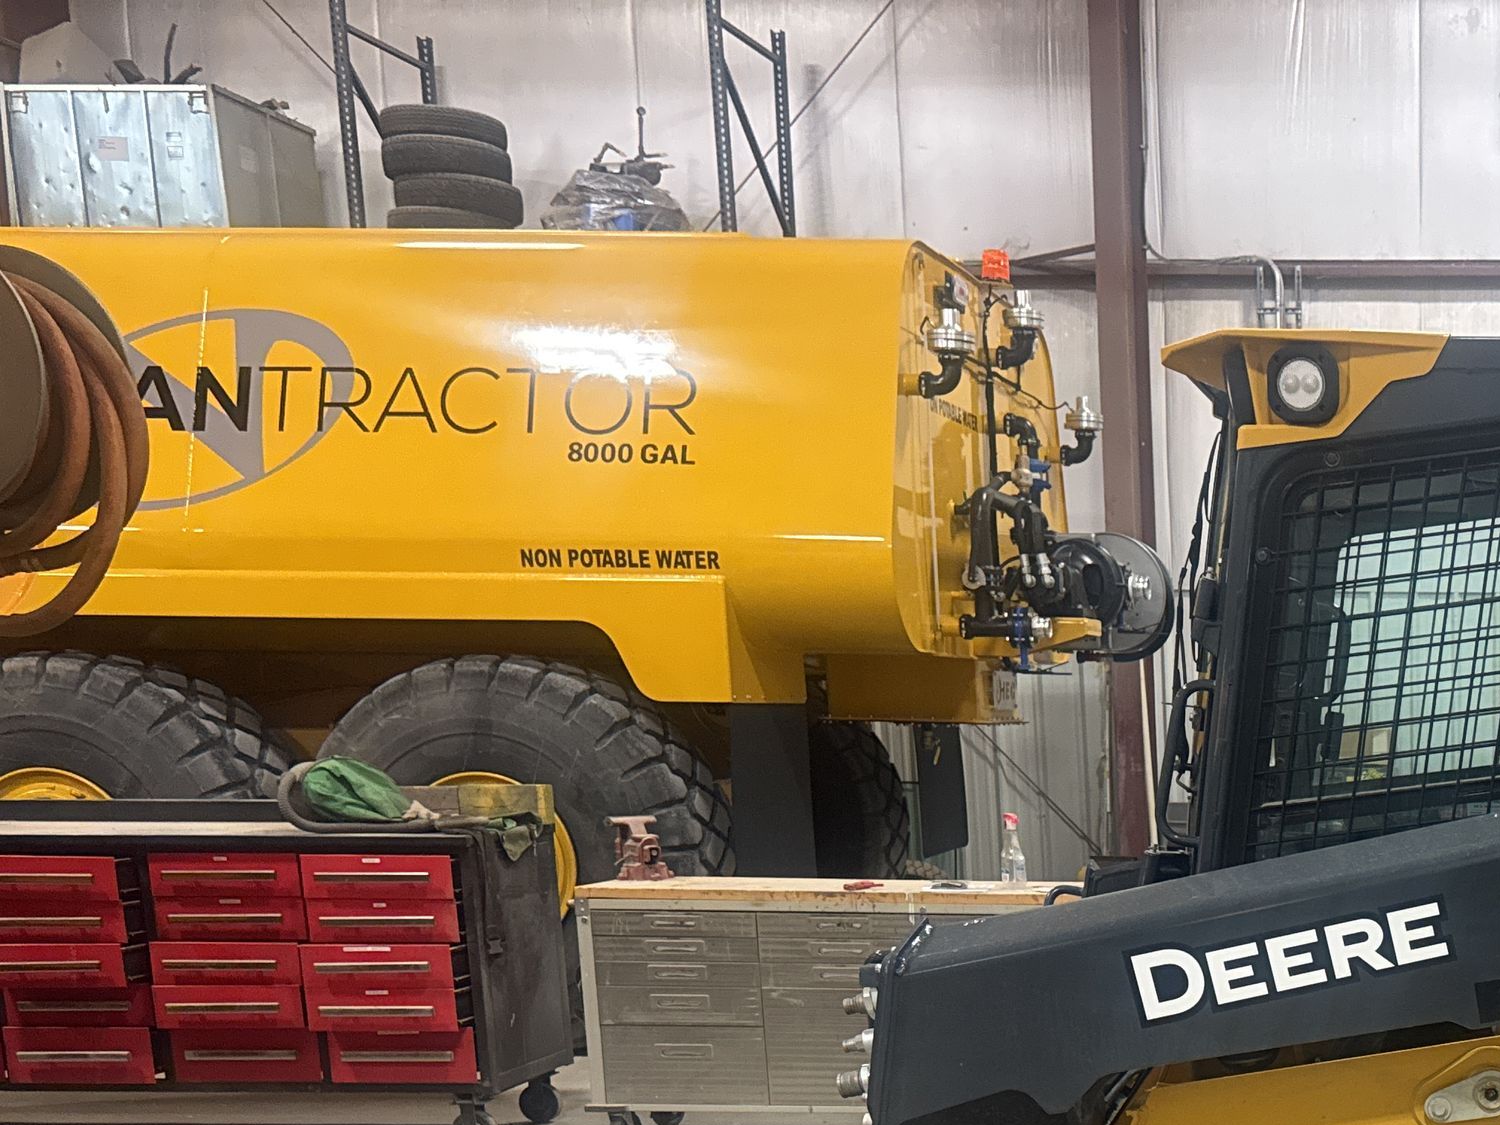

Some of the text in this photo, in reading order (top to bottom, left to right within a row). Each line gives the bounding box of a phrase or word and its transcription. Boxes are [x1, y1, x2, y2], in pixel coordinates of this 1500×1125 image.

[137, 366, 698, 435] ANTRACTOR
[567, 442, 696, 465] 8000 GAL
[520, 548, 721, 570] NON POTABLE WATER
[1130, 901, 1450, 1021] DEERE
